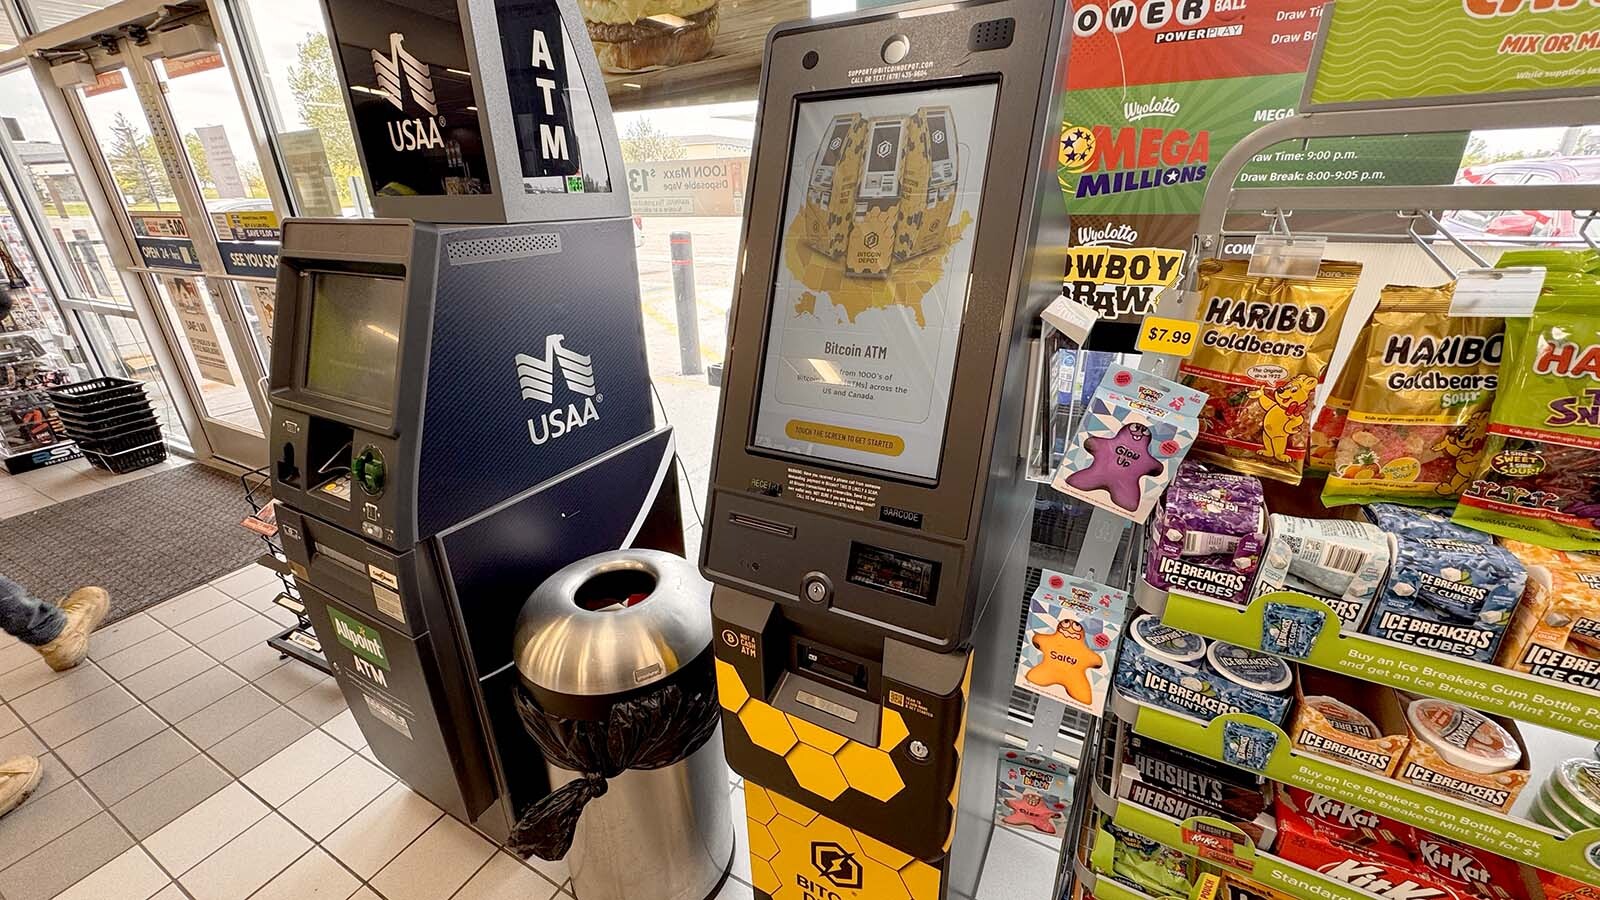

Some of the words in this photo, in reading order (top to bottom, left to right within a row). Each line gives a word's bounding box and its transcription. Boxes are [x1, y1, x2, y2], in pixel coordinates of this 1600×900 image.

[1276, 10, 1307, 22] Draw
[1310, 5, 1323, 17] Ti
[1271, 33, 1301, 45] Draw
[1498, 35, 1543, 54] MIX
[1542, 33, 1575, 54] OR
[1516, 70, 1544, 80] While
[1545, 67, 1586, 78] supplies
[531, 29, 570, 161] ATM
[1123, 95, 1180, 122] Wyolotto
[1253, 108, 1295, 122] MEGA
[389, 117, 446, 152] USAA
[1083, 124, 1210, 173] MEGA
[1275, 151, 1305, 162] Time:
[1307, 150, 1331, 161] 9:00
[1333, 151, 1358, 162] p.m.
[1076, 165, 1208, 199] MILLIONS
[1240, 172, 1267, 182] Draw
[1269, 171, 1304, 182] Break:
[1306, 170, 1359, 181] 8:00-9:05
[1361, 171, 1386, 182] p.m.
[1078, 222, 1138, 247] Wyolotto
[142, 246, 161, 259] OPEN
[230, 252, 246, 267] SEE
[246, 254, 264, 268] YOU
[1205, 298, 1327, 334] HARIBO
[1148, 326, 1192, 345] $7.99
[1203, 329, 1306, 358] Goldbears
[824, 341, 862, 358] Bitcoin
[864, 345, 888, 360] ATM
[1384, 335, 1504, 366] HARIBO
[839, 368, 856, 377] from
[858, 370, 883, 381] 1000's
[884, 374, 893, 382] of
[1388, 371, 1498, 390] Goldbears
[822, 387, 832, 395] US
[833, 389, 847, 397] and
[869, 383, 893, 392] across
[895, 386, 908, 395] the
[1442, 391, 1481, 408] Sour
[527, 397, 600, 446] USAA
[795, 425, 813, 436] TOUCH
[813, 427, 825, 436] THE
[824, 429, 847, 441] SCREEN
[847, 434, 855, 443] TO
[855, 436, 866, 445] GET
[867, 438, 894, 449] STARTED
[1115, 445, 1141, 461] Glow
[1116, 456, 1131, 468] Up
[1495, 455, 1538, 465] SWEET
[1500, 465, 1541, 475] SOUR!
[883, 506, 919, 522] BARCODE
[1508, 522, 1544, 533] CANDY
[1160, 557, 1182, 575] ICE
[1181, 562, 1247, 592] BREAKERS
[1165, 574, 1187, 587] ICE
[1187, 578, 1234, 598] CUBES
[1433, 577, 1488, 600] BREAKERS
[1438, 589, 1475, 605] CUBES
[335, 618, 384, 660] Allpoint
[1379, 612, 1410, 631] ICE
[1409, 618, 1495, 650] BREAKERS
[741, 645, 756, 658] ATM
[1386, 630, 1415, 644] ICE
[1415, 636, 1477, 657] CUBES
[1049, 650, 1077, 666] Salty
[1222, 656, 1237, 667] ICE
[1236, 656, 1279, 668] BREAKERS
[1525, 644, 1563, 667] ICE
[354, 655, 389, 689] ATM
[1145, 672, 1168, 693] ICE
[1348, 648, 1375, 663] Buy
[1377, 656, 1394, 667] an
[1398, 661, 1419, 673] Ice
[1422, 667, 1487, 690] Breakers
[1491, 684, 1528, 700] Gum
[1532, 694, 1582, 714] Bottle
[1531, 665, 1567, 683] ICE
[1168, 694, 1209, 715] MINTS
[1339, 659, 1365, 671] and
[1367, 666, 1391, 678] get
[1393, 673, 1410, 682] an
[1414, 677, 1435, 689] Ice
[1438, 682, 1505, 706] Breakers
[1508, 700, 1545, 716] Mint
[1549, 710, 1573, 724] Tin
[1577, 718, 1600, 730] for
[1299, 730, 1323, 748] ICE
[1322, 740, 1391, 771] BREAKERS
[1135, 754, 1223, 802] HERSHEY'S
[1405, 762, 1432, 782] ICE
[1431, 775, 1509, 806] BREAKERS
[1132, 785, 1221, 819] HERSHE'
[1172, 787, 1187, 796] milk
[1291, 773, 1314, 785] and
[1316, 781, 1338, 793] get
[1339, 789, 1354, 798] an
[1357, 793, 1376, 805] Ice
[1379, 801, 1436, 824] Breakers
[1439, 820, 1472, 835] Mint
[1475, 831, 1496, 844] Tin
[1499, 840, 1521, 852] for
[1522, 848, 1541, 859] $1
[1299, 765, 1322, 779] Buy
[1324, 774, 1341, 784] an
[1342, 779, 1361, 790] Ice
[1364, 785, 1420, 809] Breakers
[1423, 805, 1456, 820] Gum
[1459, 816, 1502, 835] Bottle
[1505, 831, 1543, 849] Pack
[1307, 793, 1380, 829] KitKat
[1420, 840, 1491, 884] KitKat
